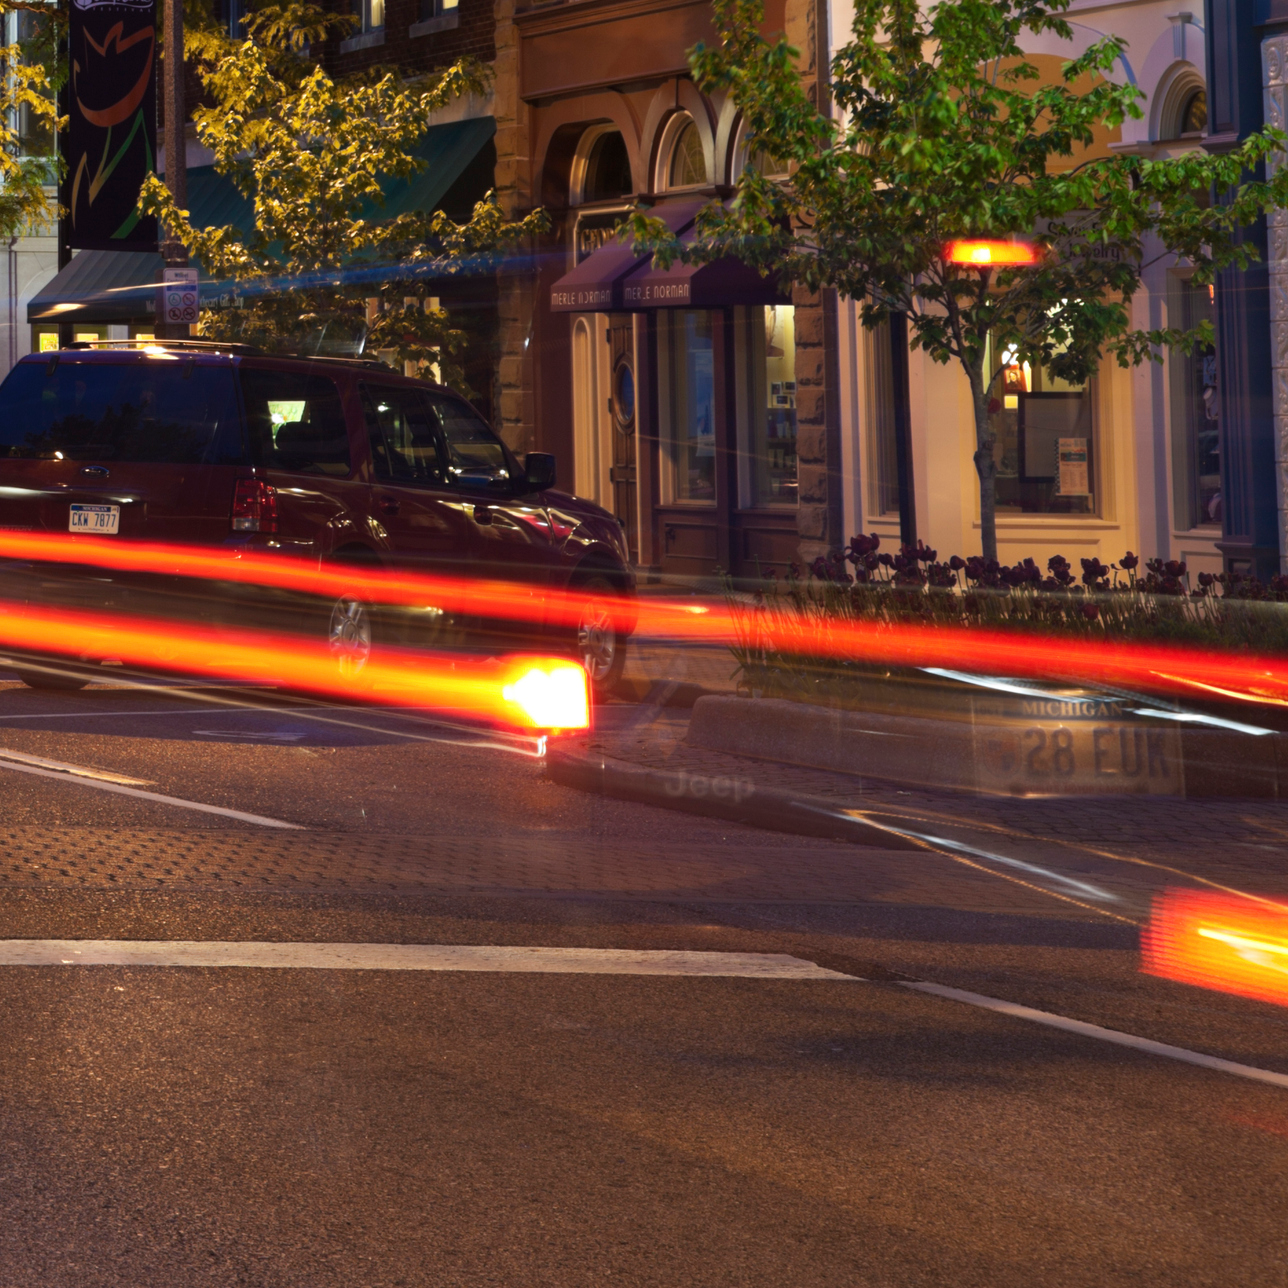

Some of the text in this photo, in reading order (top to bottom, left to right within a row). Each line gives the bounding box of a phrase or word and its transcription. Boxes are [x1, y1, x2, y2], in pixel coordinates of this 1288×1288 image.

[551, 291, 576, 306] MERLE
[653, 283, 690, 300] NORMAN
[71, 511, 117, 528] CKW 7877
[1022, 700, 1123, 718] MICHIGAN
[1024, 726, 1076, 779] 28
[664, 770, 756, 801] Jeep
